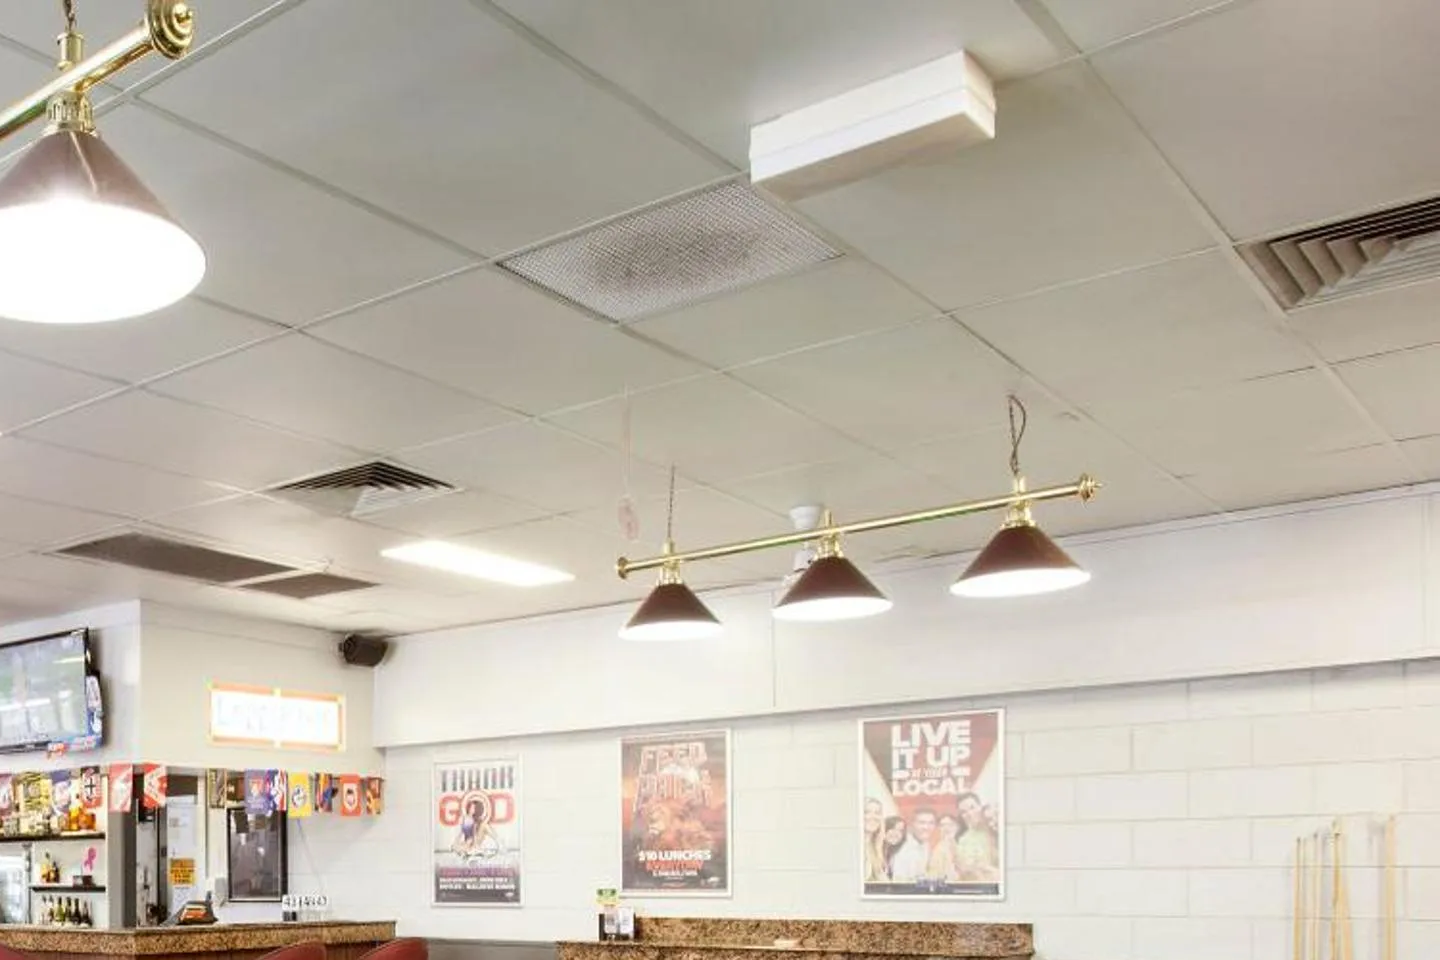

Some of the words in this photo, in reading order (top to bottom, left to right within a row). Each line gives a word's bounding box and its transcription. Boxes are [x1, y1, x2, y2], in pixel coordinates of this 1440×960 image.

[891, 720, 971, 748] LIVE
[892, 748, 920, 769] IT
[926, 745, 971, 767] UP
[892, 777, 971, 797] LOCAL
[658, 849, 711, 861] LUNCHES
